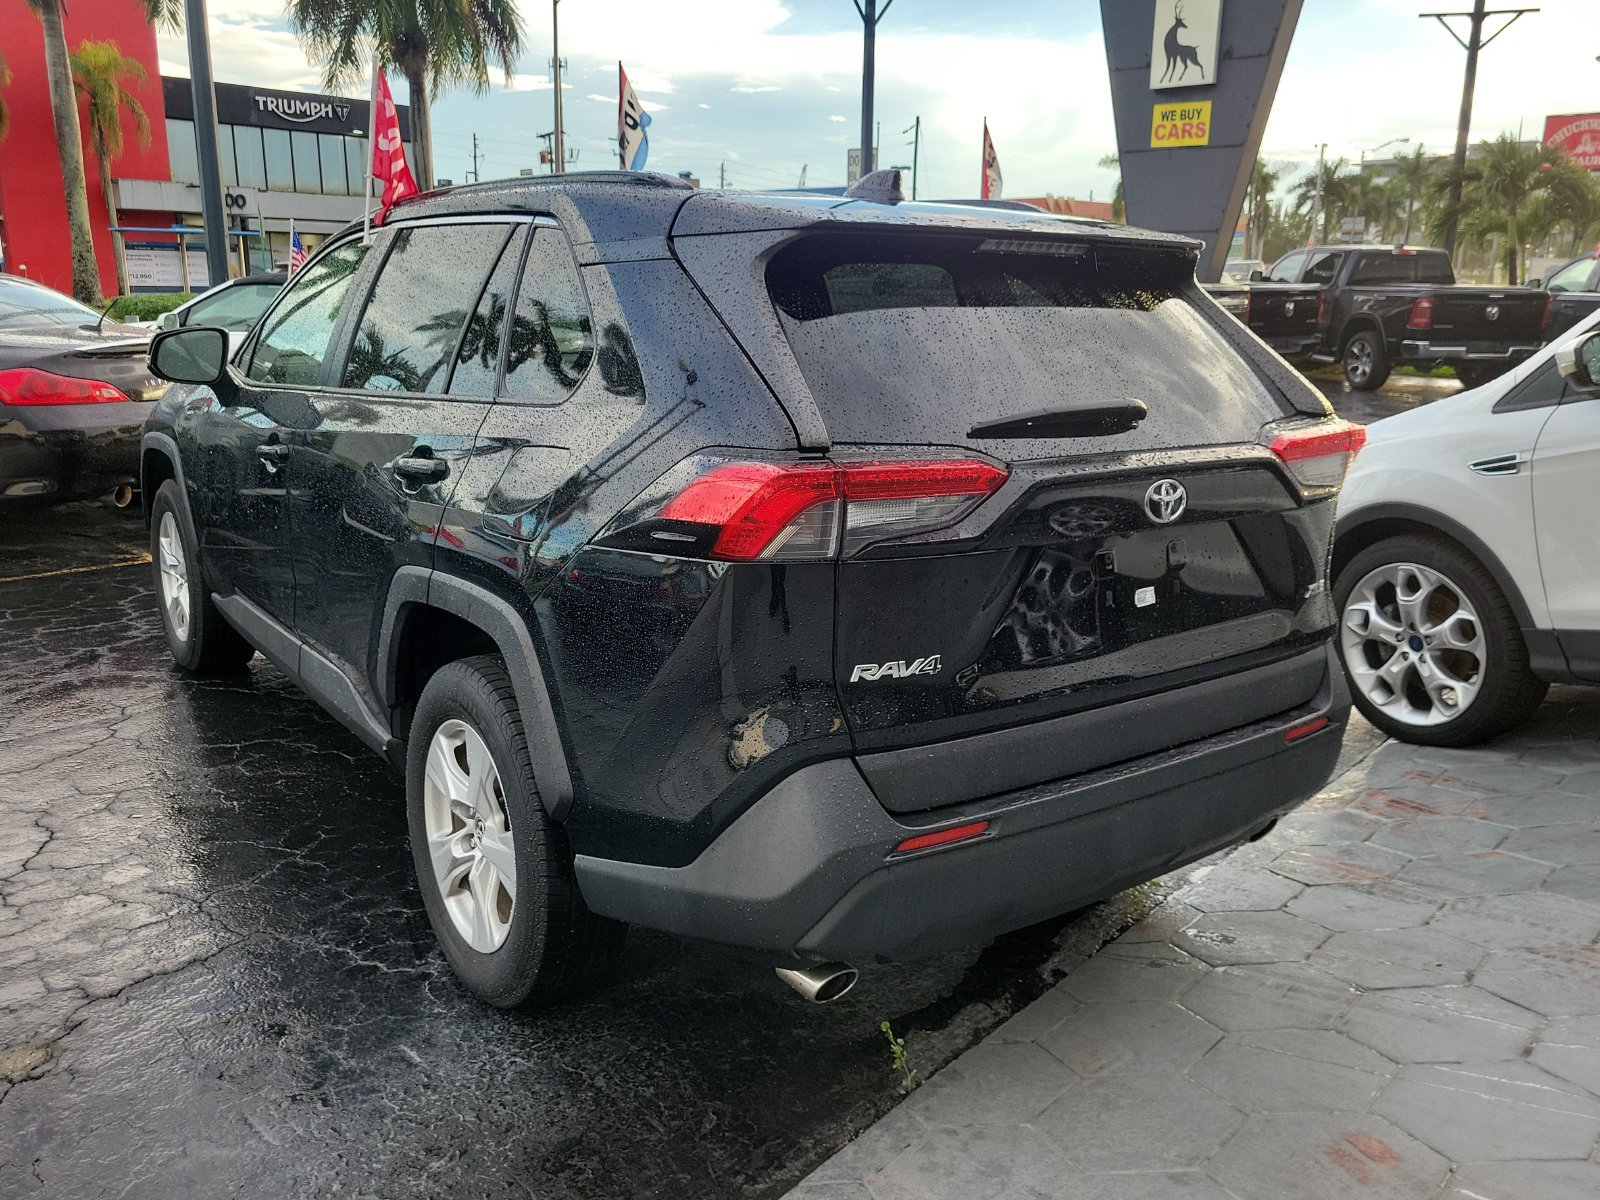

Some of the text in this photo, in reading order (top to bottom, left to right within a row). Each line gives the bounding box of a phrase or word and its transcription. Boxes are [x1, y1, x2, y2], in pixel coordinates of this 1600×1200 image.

[255, 95, 333, 121] TRIUMPH
[1161, 108, 1203, 122] WE BUY
[1154, 121, 1207, 140] CARS
[850, 654, 942, 682] RAV4
